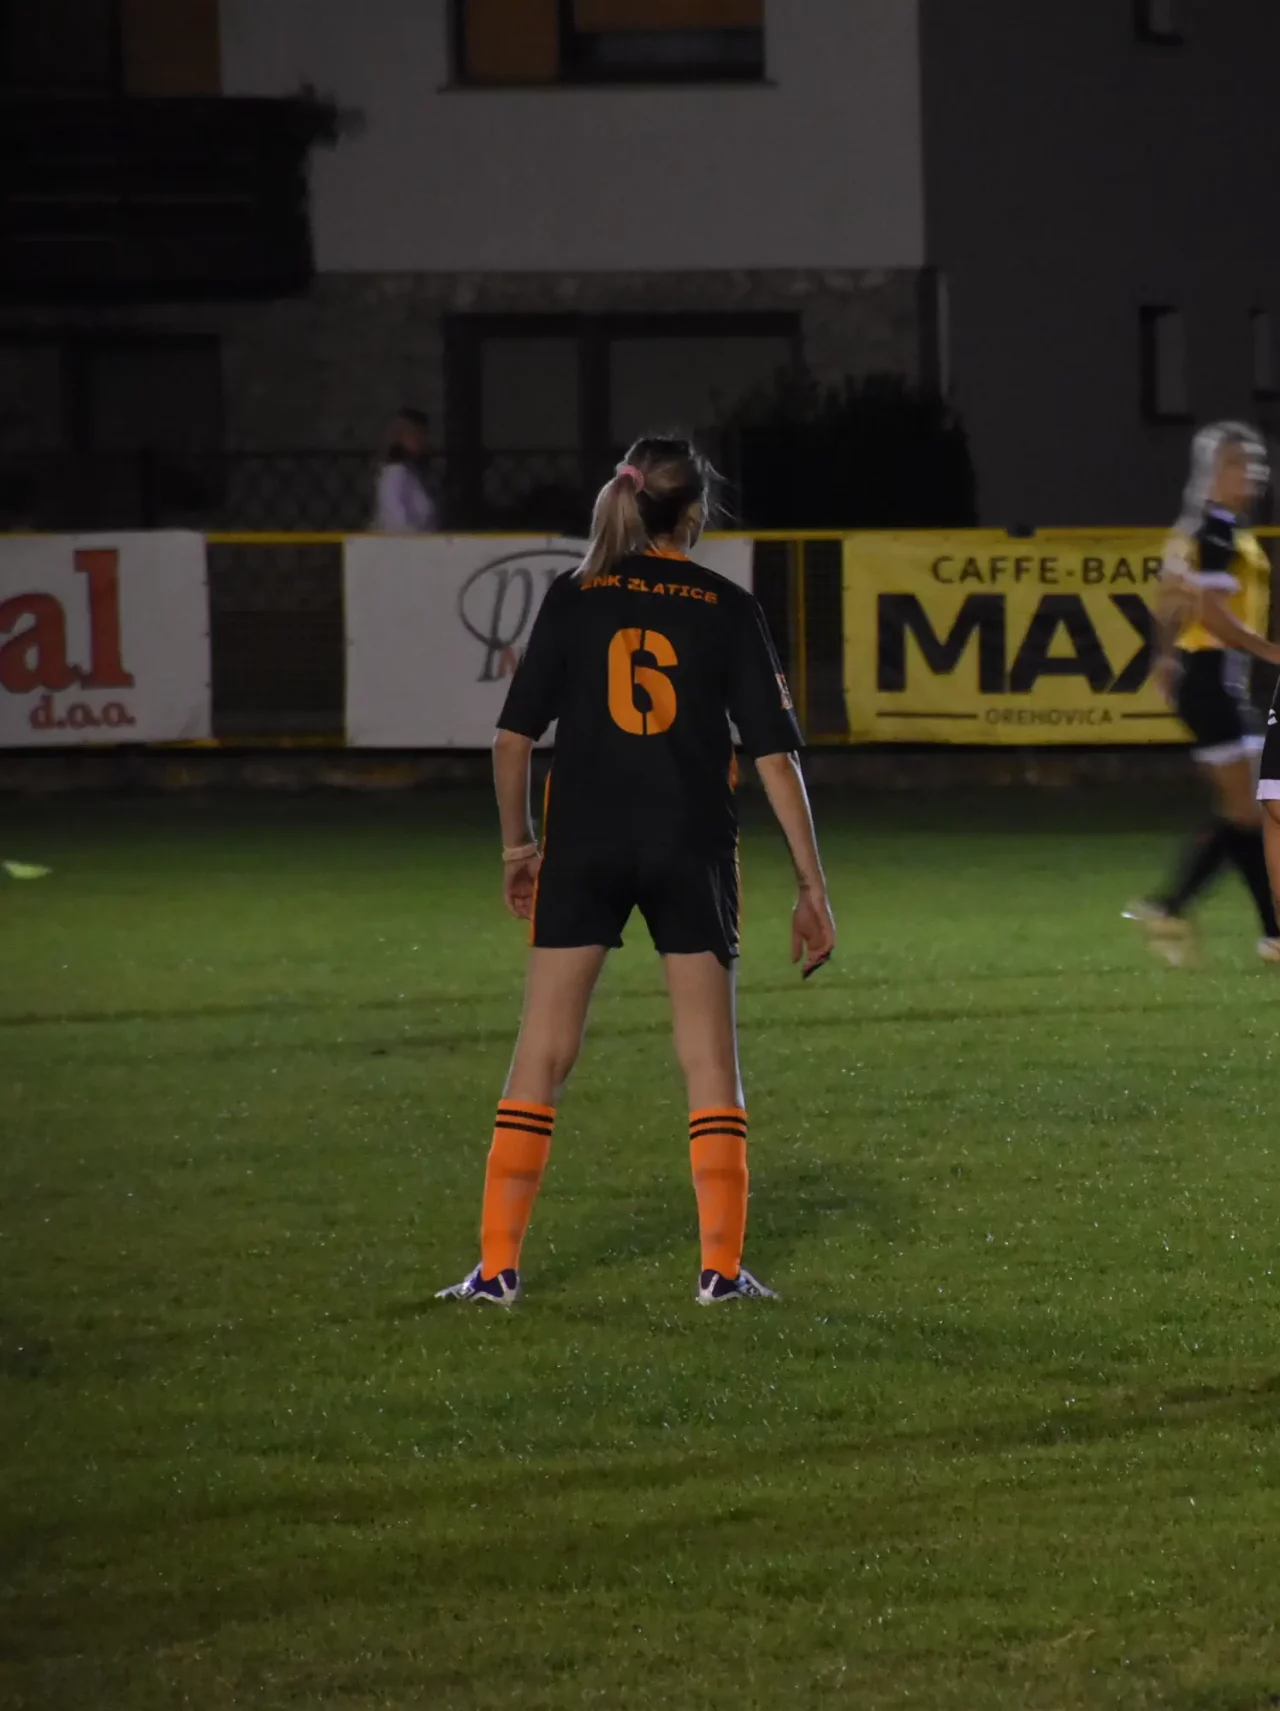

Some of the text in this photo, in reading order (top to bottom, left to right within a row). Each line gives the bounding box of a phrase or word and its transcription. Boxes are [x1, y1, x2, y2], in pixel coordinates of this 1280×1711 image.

[931, 555, 1164, 585] CAFFE-BAR
[627, 577, 719, 604] ZLATICE
[607, 627, 679, 736] 6
